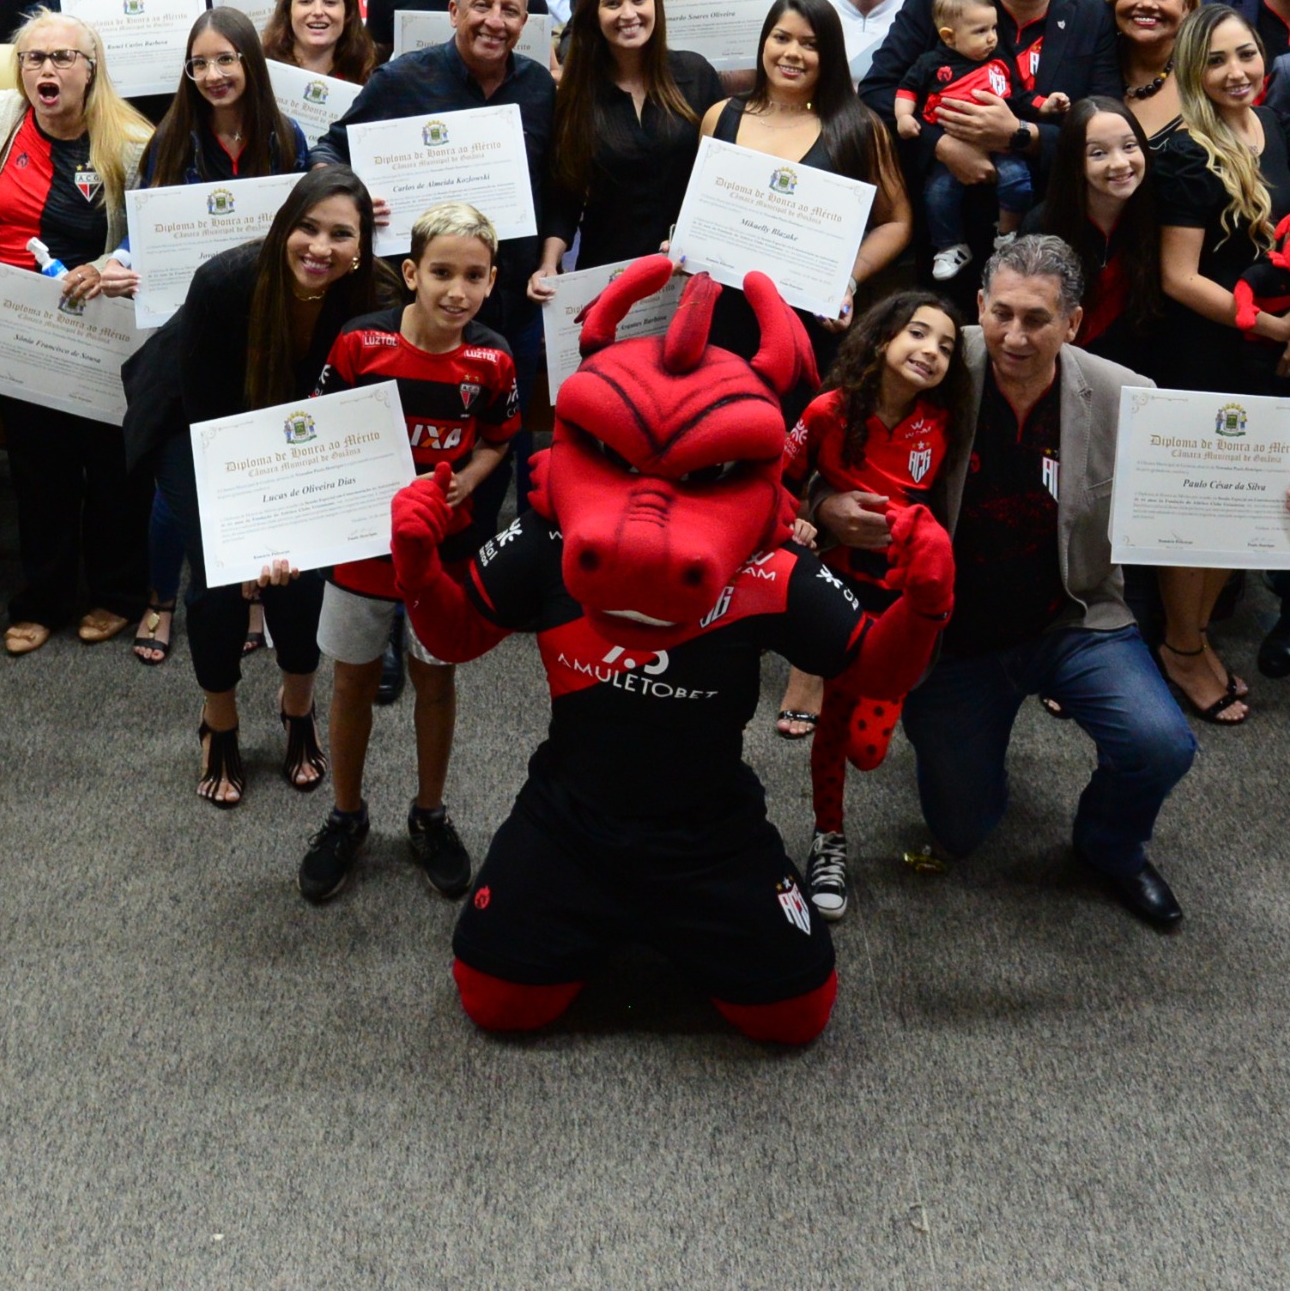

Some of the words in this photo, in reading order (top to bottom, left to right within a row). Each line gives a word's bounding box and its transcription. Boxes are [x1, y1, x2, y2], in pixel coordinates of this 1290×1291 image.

[392, 182, 415, 193] Carlos
[417, 182, 425, 190] de
[428, 178, 454, 188] Almeida
[741, 218, 770, 233] Mikaelly
[364, 335, 398, 347] LUZTOL
[464, 349, 499, 364] LUZTOL
[1150, 434, 1197, 449] Diploma
[1201, 439, 1213, 449] de
[1215, 438, 1250, 452] Honra
[1254, 444, 1265, 452] ao
[262, 489, 288, 503] Lucas
[290, 488, 300, 497] de
[302, 480, 335, 495] Oliveira
[337, 476, 356, 487] Dias
[1183, 479, 1207, 488] Paulo
[1210, 479, 1233, 490] César
[1235, 482, 1245, 490] da
[1247, 482, 1266, 491] Silva
[558, 653, 719, 699] AMULETOBET
